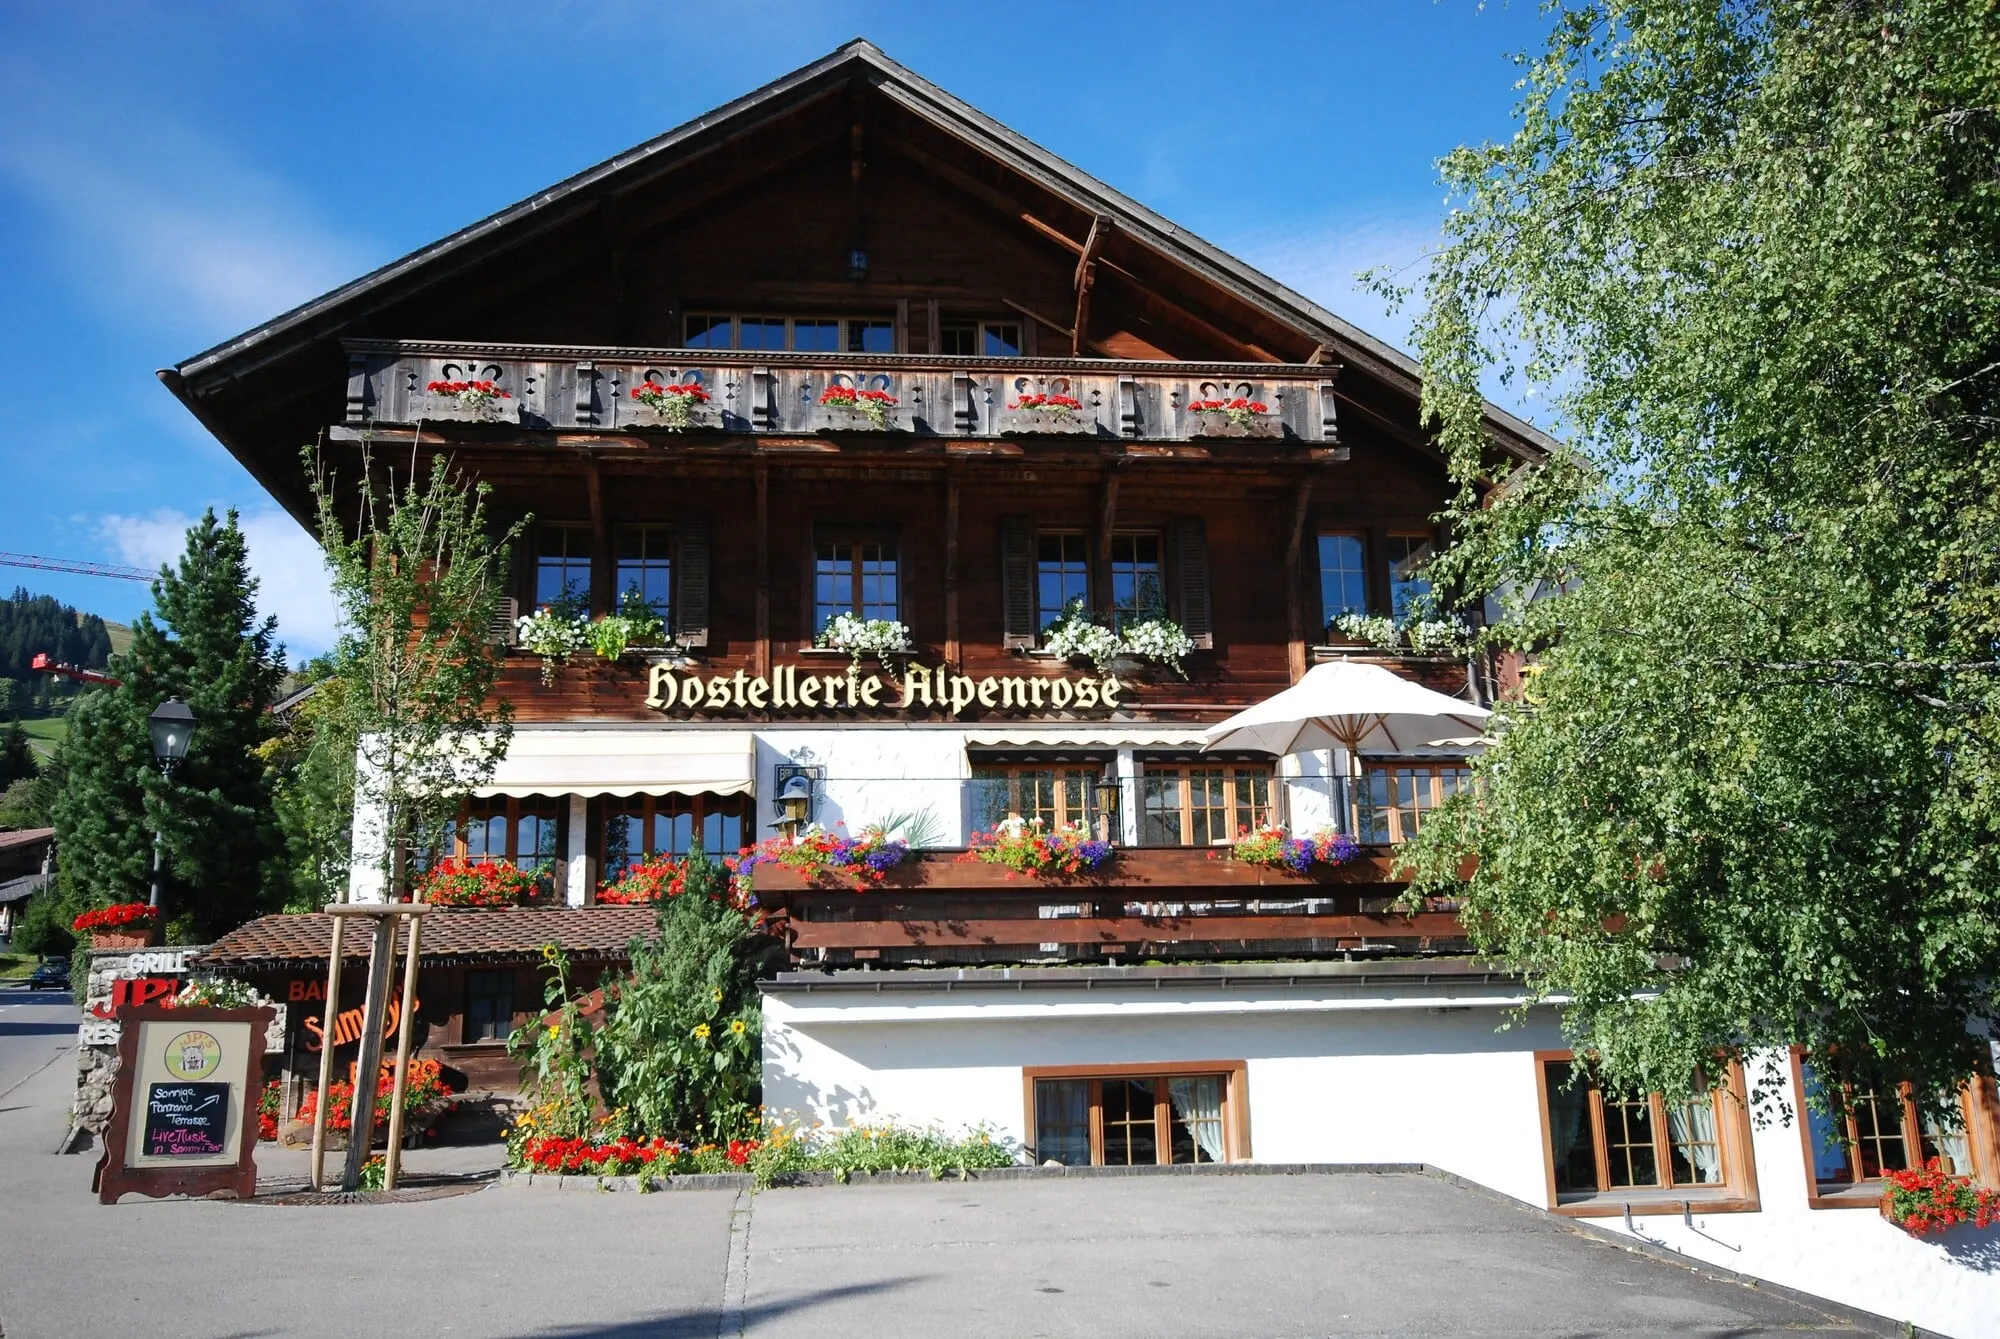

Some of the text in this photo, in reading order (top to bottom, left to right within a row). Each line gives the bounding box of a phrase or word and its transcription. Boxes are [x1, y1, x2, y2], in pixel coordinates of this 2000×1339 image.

[645, 661, 1122, 715] Hostellerie Alpenrose
[127, 953, 190, 974] GRILL
[288, 980, 329, 1001] BA
[349, 1058, 442, 1081] BSRO
